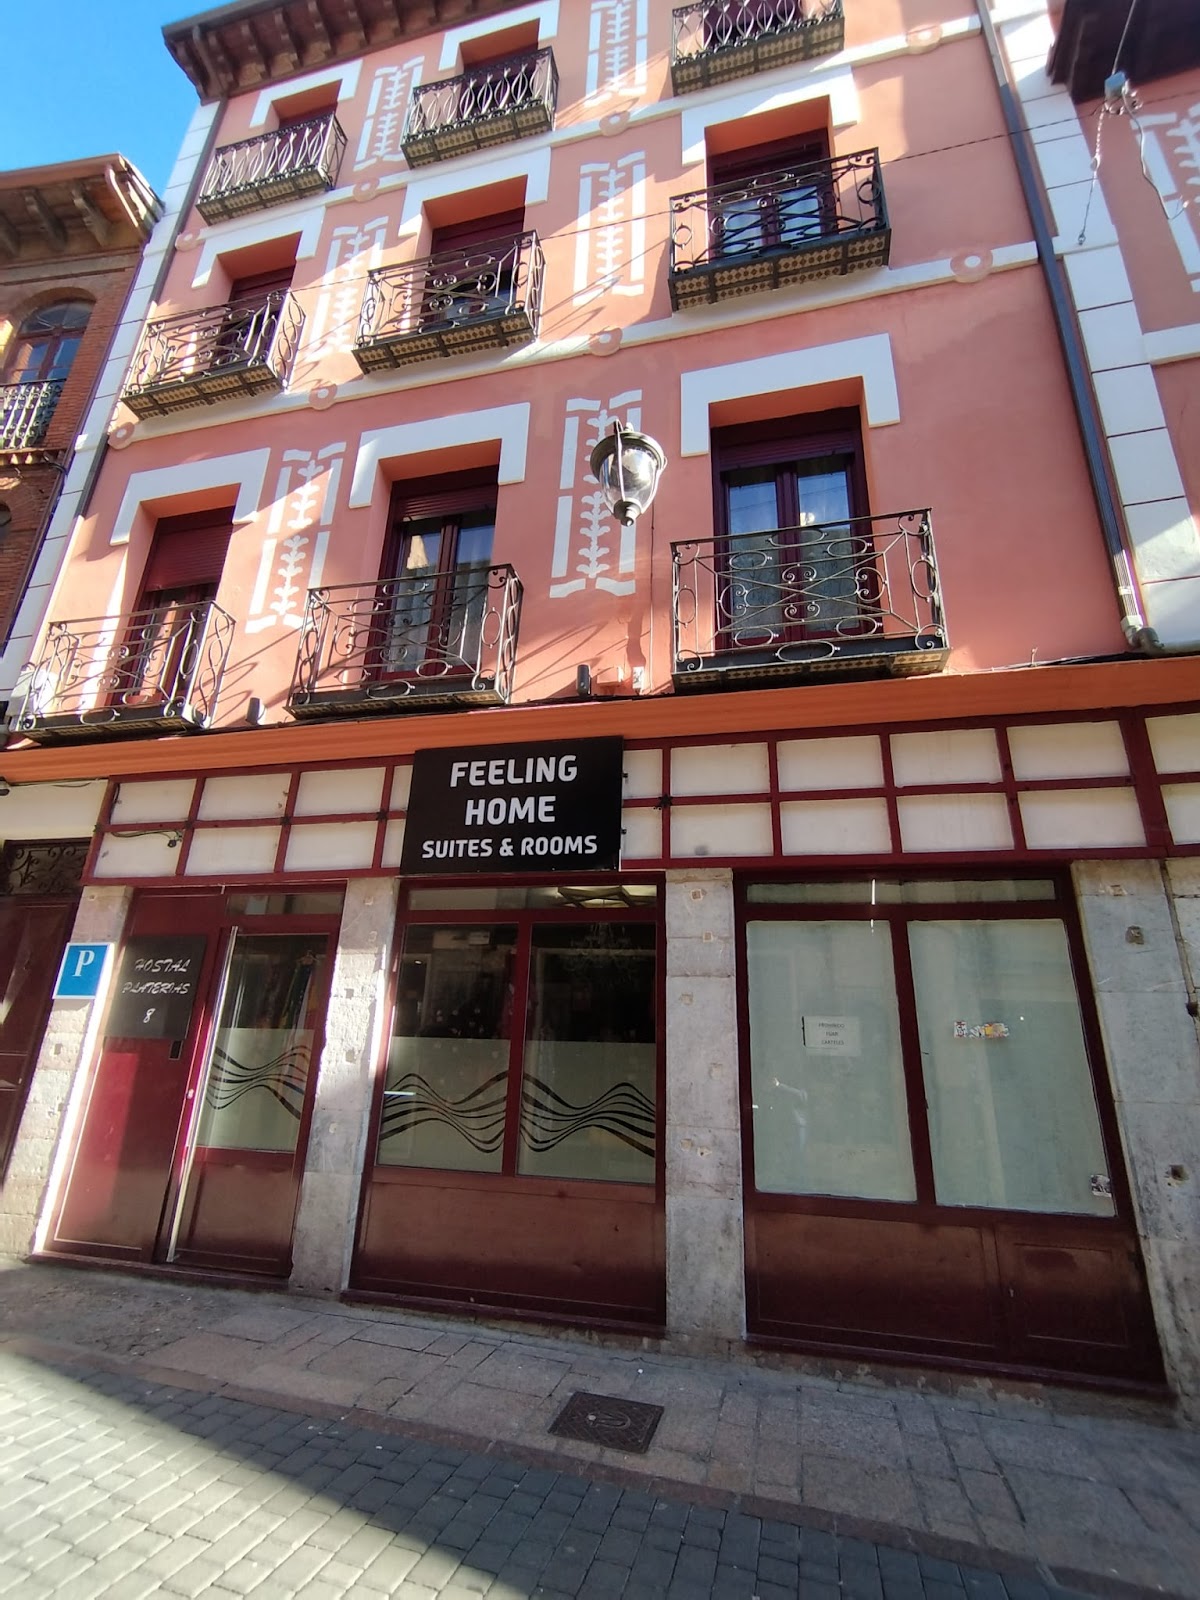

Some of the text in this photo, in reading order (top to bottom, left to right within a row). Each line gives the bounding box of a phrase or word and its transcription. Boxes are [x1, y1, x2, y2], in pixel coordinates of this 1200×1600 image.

[450, 755, 578, 788] FEELING
[465, 796, 556, 825] HOME
[422, 835, 598, 859] SUITES & ROOMS
[72, 950, 95, 977] P
[135, 958, 191, 973] HOSTAL
[122, 981, 191, 995] PLATERIAS
[143, 1008, 156, 1024] 8
